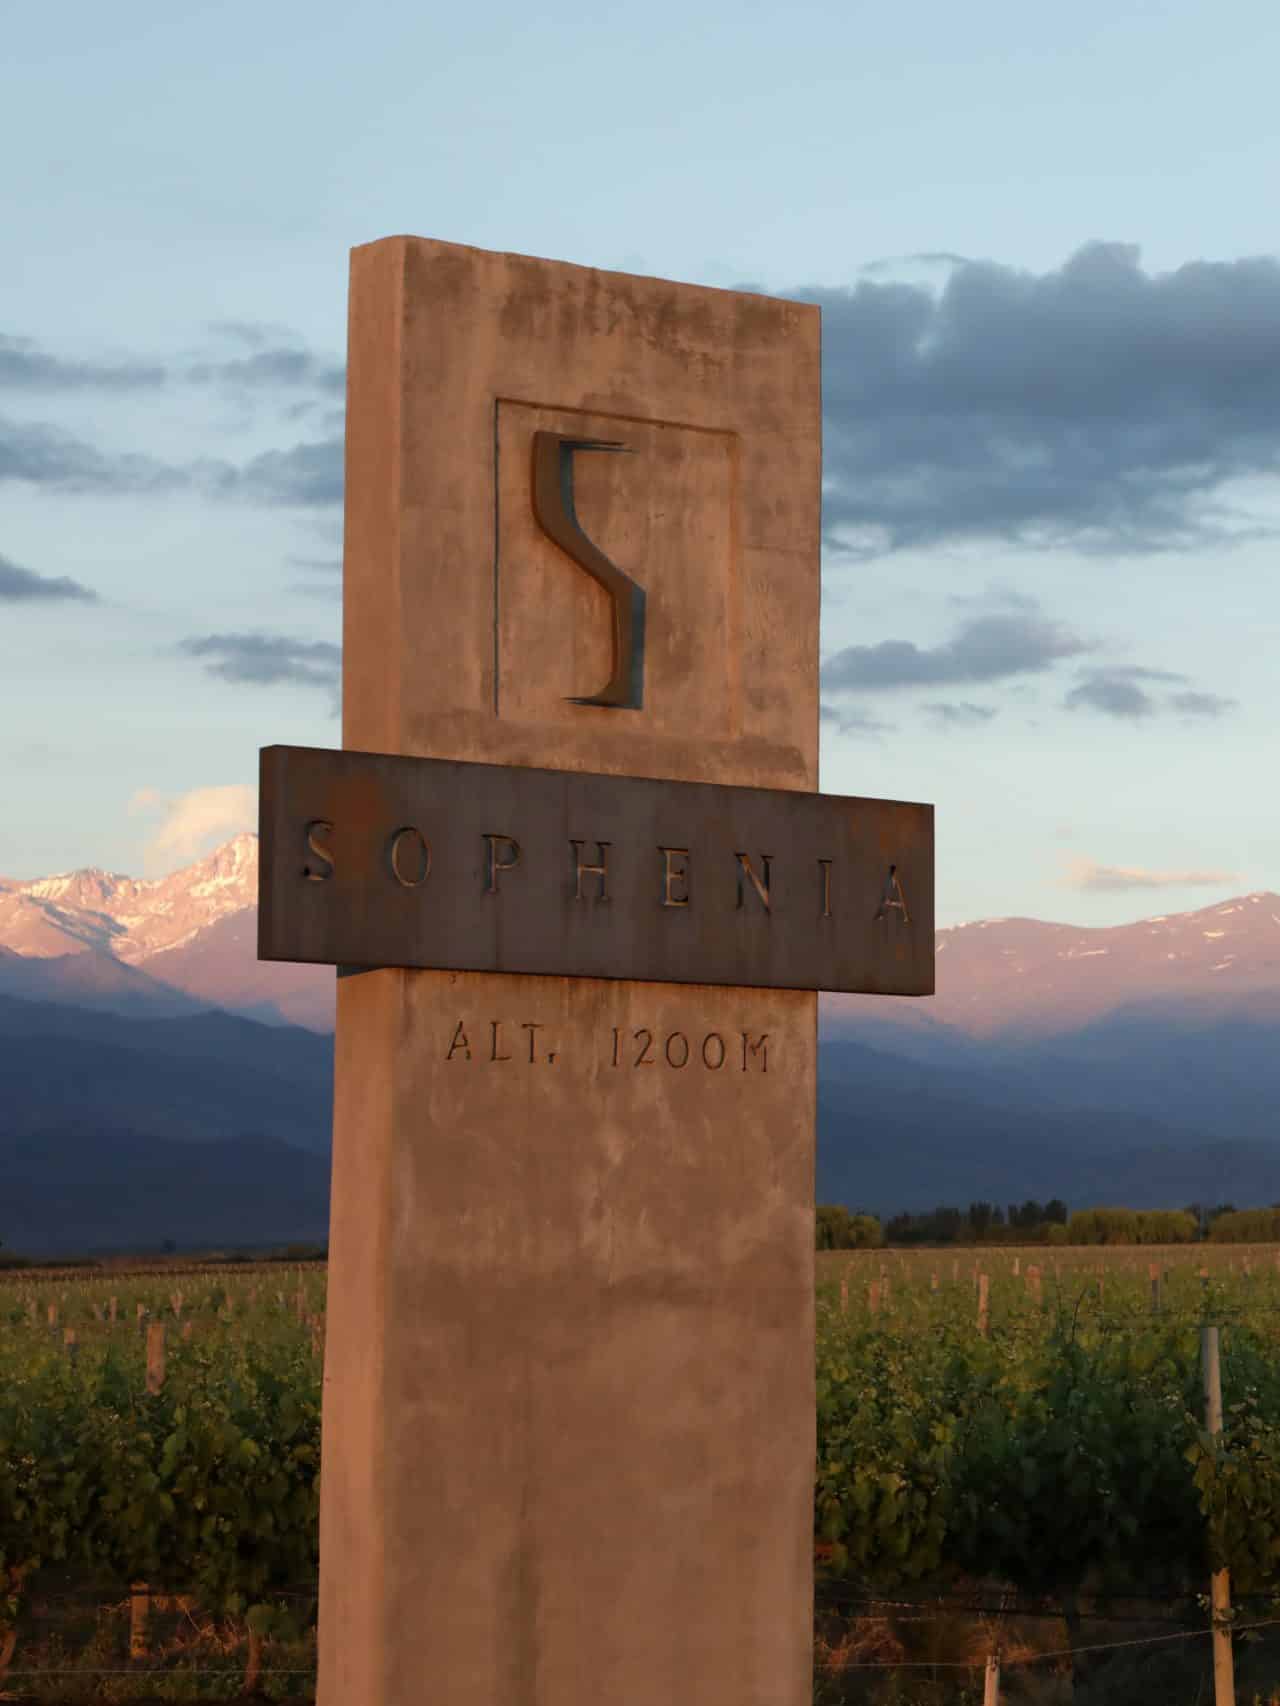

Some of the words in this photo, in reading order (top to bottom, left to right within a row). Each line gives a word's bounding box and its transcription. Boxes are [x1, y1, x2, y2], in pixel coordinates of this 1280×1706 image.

[302, 819, 913, 923] SOPHENIA
[445, 1020, 556, 1064] ALT.
[611, 1027, 770, 1073] 1200M
